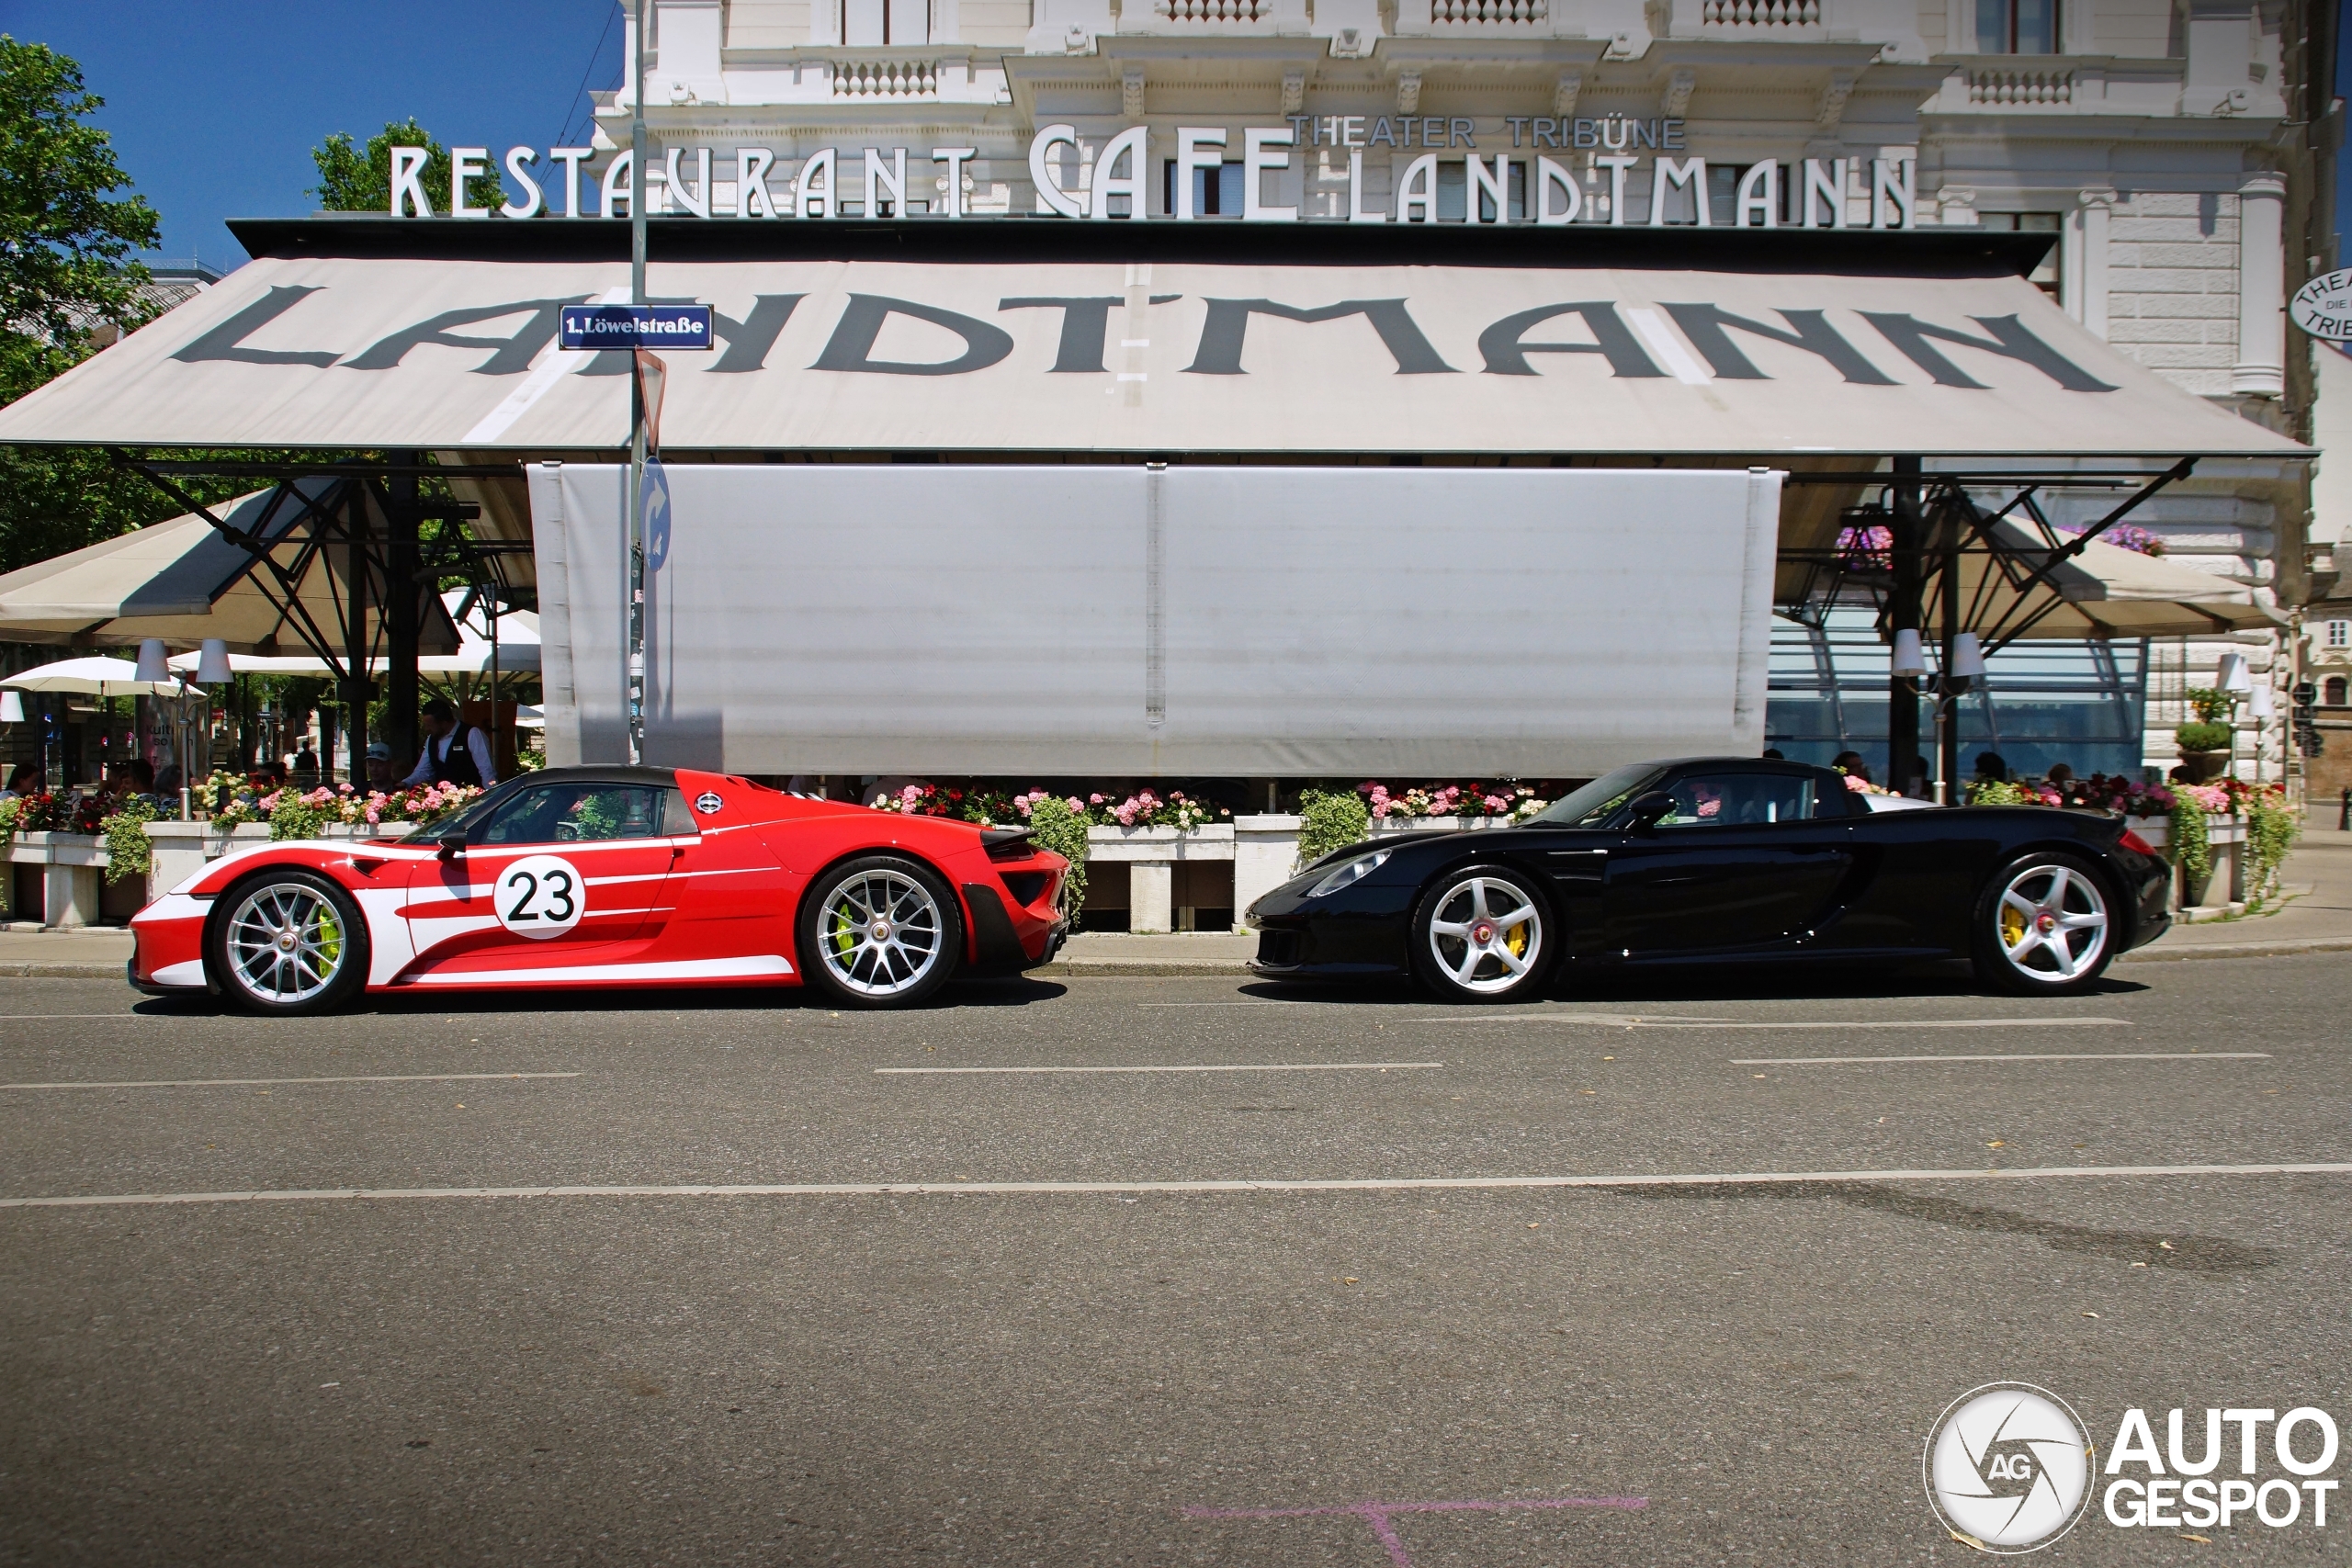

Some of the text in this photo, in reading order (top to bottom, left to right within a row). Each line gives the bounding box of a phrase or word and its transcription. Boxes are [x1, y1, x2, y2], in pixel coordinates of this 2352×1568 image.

[1285, 111, 1686, 150] THEATER TRIBÜNE
[390, 123, 1918, 230] RESTAURANT CAFE LANDTMANN
[583, 317, 704, 334] Löwelstraße
[2325, 299, 2347, 310] DIE
[169, 284, 2123, 393] LANDTMANN
[506, 869, 575, 922] 23
